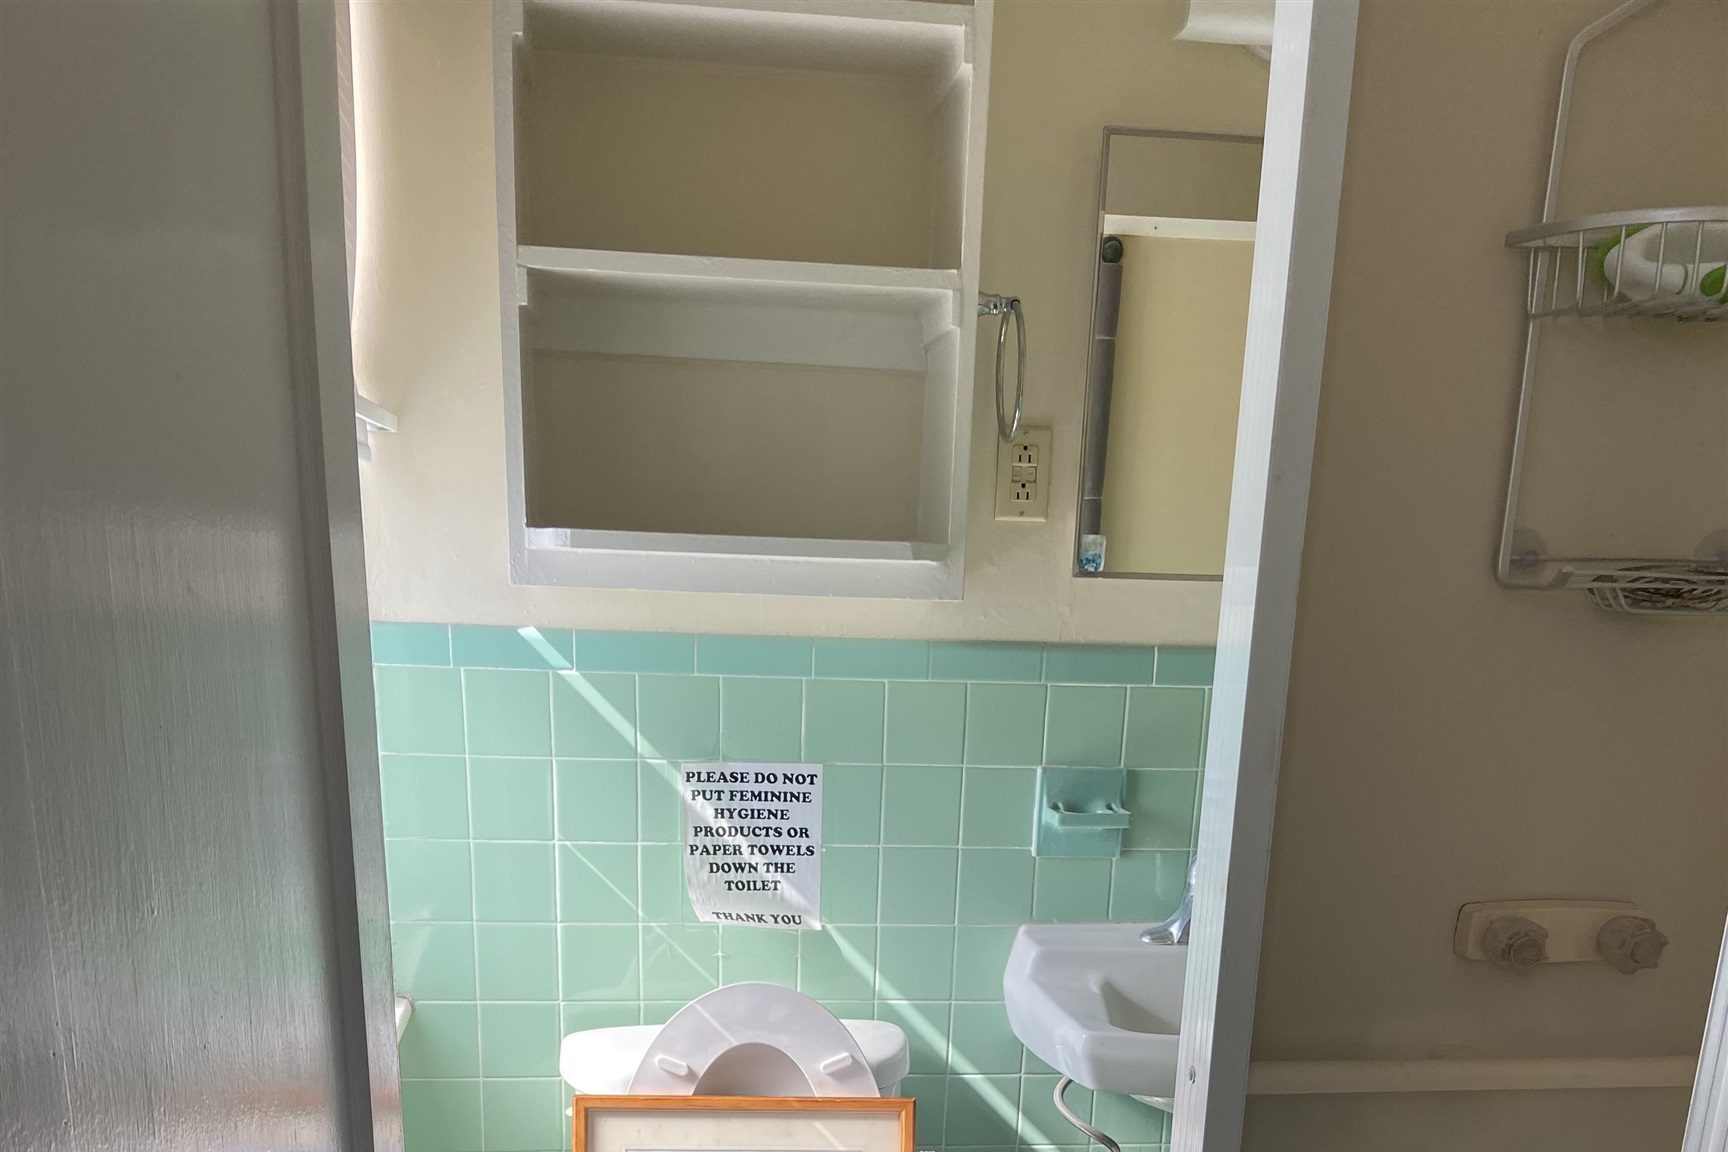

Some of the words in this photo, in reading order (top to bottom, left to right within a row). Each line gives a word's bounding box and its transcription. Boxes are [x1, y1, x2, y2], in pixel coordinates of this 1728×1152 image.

[686, 772, 750, 783] PLEASE
[754, 773, 777, 784] DO
[783, 773, 817, 785] NOT
[691, 790, 725, 800] PUT
[729, 791, 812, 803] FEMININE
[714, 808, 789, 820] HYGIENE
[693, 826, 782, 838] PRODUCTS
[787, 827, 810, 838] OR
[689, 845, 743, 855] PAPER
[748, 845, 815, 856] TOWELS
[709, 862, 759, 873] DOWN
[763, 863, 796, 873] THE
[724, 880, 781, 891] TOILET
[712, 912, 768, 924] THANK
[770, 914, 802, 925] YOU
